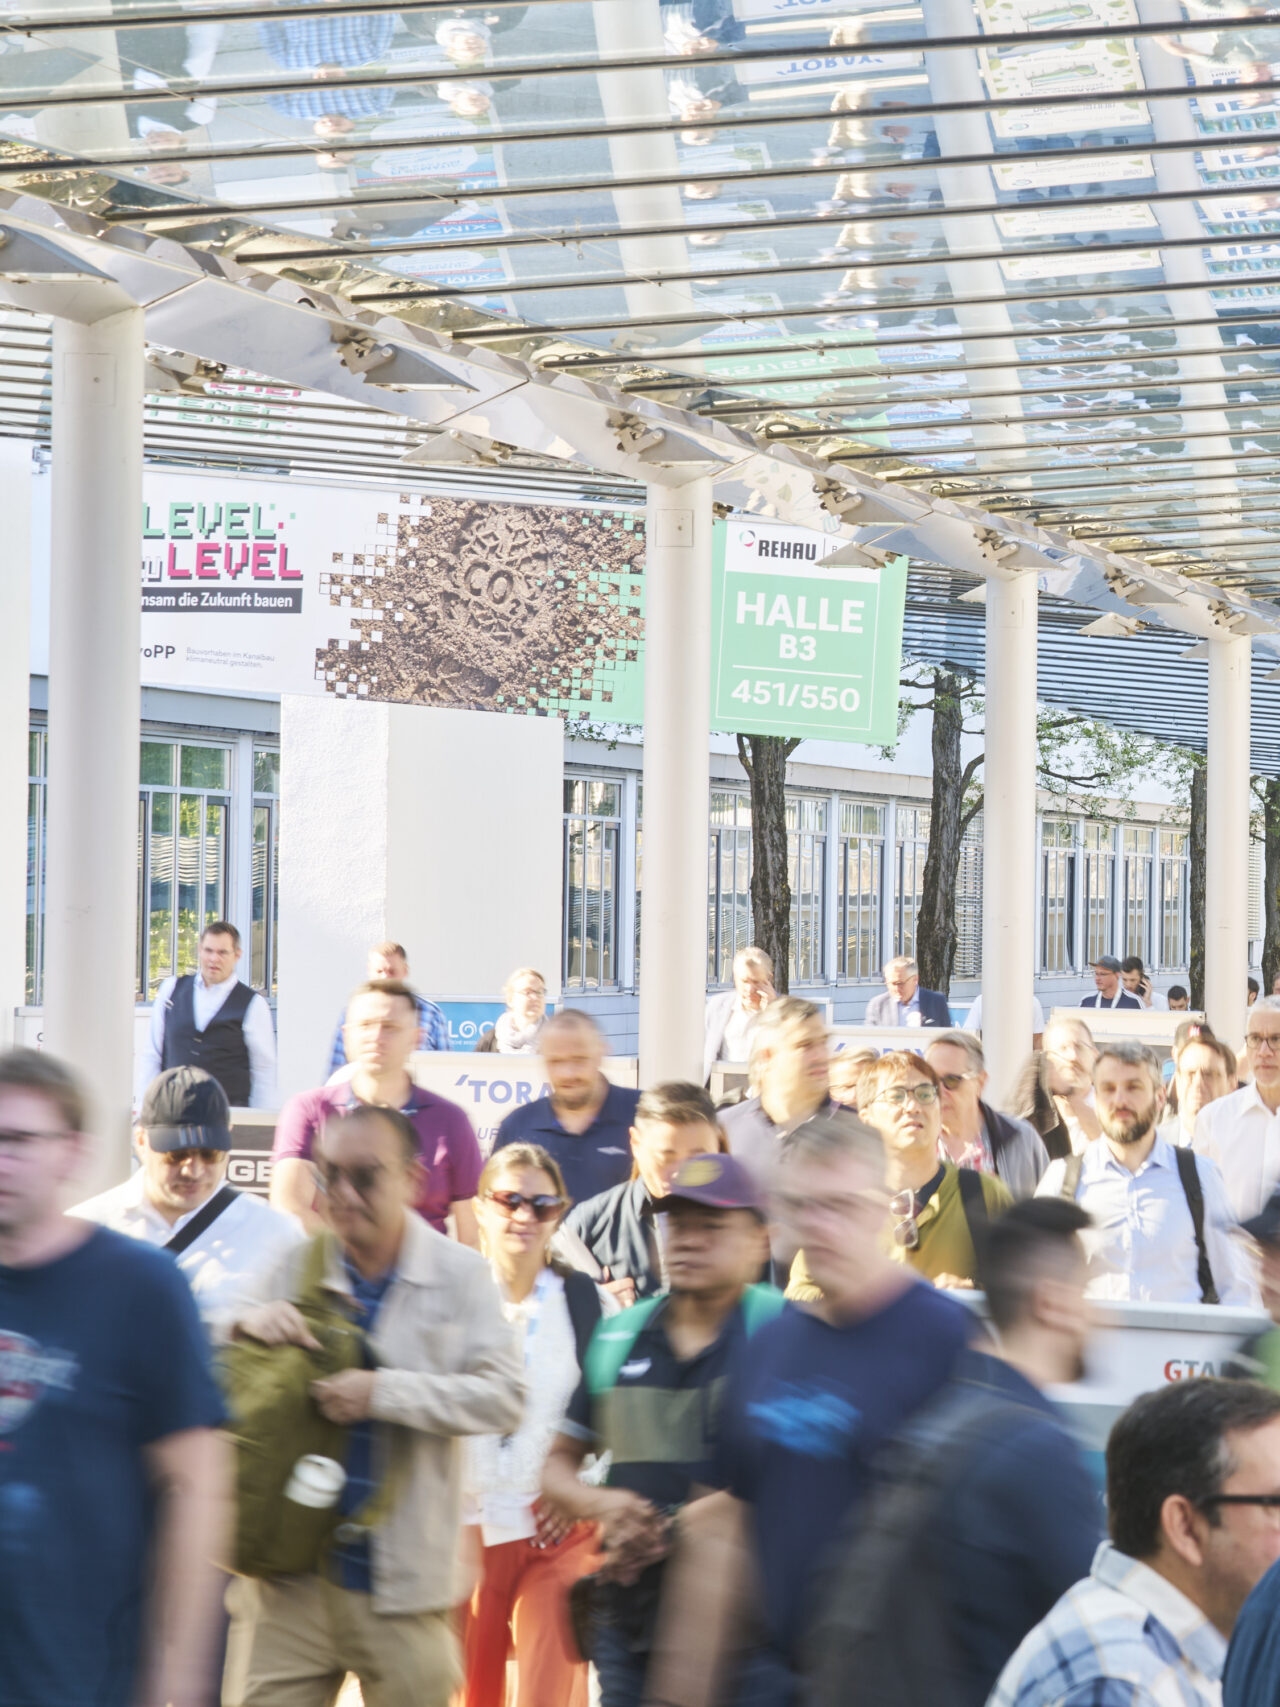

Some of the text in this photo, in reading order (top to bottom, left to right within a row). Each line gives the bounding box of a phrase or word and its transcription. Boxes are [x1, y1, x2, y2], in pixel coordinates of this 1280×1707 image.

[142, 502, 277, 539] LEVEL
[167, 543, 304, 581] LEVEL
[758, 539, 817, 561] REHAU
[178, 592, 198, 607] die
[200, 592, 252, 608] Zukunft
[254, 593, 293, 608] bauen
[736, 591, 865, 634] HALLE
[778, 634, 817, 661] B3
[731, 679, 860, 712] 451/550
